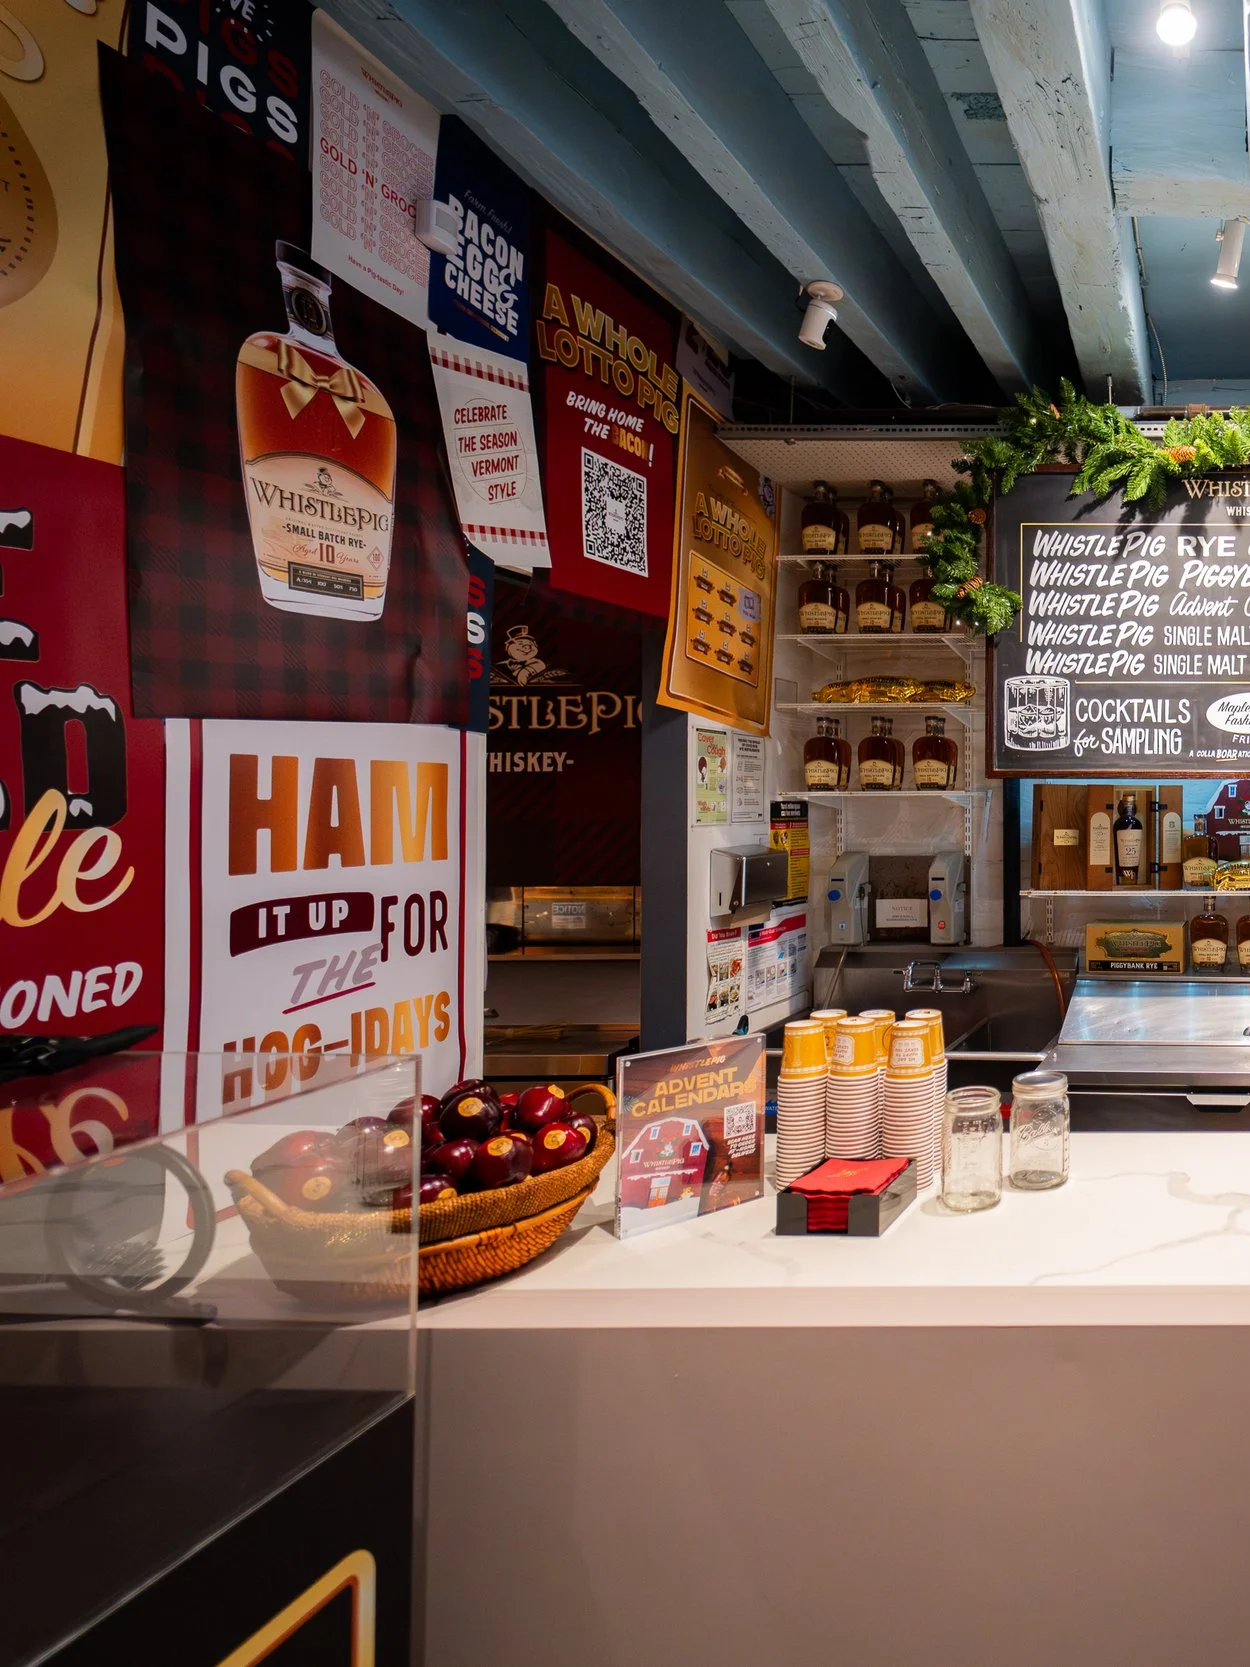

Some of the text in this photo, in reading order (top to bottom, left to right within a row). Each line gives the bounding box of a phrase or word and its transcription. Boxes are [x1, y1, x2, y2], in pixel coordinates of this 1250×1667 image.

[145, 1, 298, 143] PIGS
[320, 69, 360, 110] GOLD
[320, 86, 359, 127] GOLD
[320, 103, 359, 143] GOLD
[320, 119, 358, 159] GOLD
[320, 153, 357, 192] GOLD
[320, 137, 357, 175] GOLD
[381, 183, 416, 219] GROC
[320, 171, 357, 208] GOLD
[320, 188, 356, 224] GOLD
[320, 204, 356, 240] GOLD
[449, 193, 524, 282] BACON
[445, 262, 519, 336] CHEESE
[543, 282, 569, 327] A
[571, 294, 679, 402] WHOLE
[536, 320, 634, 396] LOTTO
[638, 375, 679, 434] PIG
[454, 404, 508, 425] CELEBRATE
[566, 391, 645, 433] BRING HOME
[458, 431, 518, 453] THE SEASON
[584, 417, 654, 468] THE BACON!
[471, 454, 520, 478] VERMONT
[250, 476, 389, 532] WHISTLEPIG
[488, 481, 516, 501] STYLE
[318, 530, 346, 546] BATCH
[692, 514, 742, 556] LOTTO
[696, 492, 767, 560] A WHOLE
[1033, 529, 1166, 558] WHISTLEPIG
[1178, 536, 1236, 557] RYE
[292, 543, 359, 565] Aged 10 Years
[1029, 559, 1170, 588] WHISTLEPIG
[1028, 590, 1160, 618] WHISTLEPIG
[1169, 592, 1239, 617] Advent
[1027, 620, 1154, 647] WHISTLEPIG
[1164, 626, 1212, 646] SINGLE
[1025, 648, 1146, 676] WHISTLEPIG
[1153, 654, 1203, 675] SINGLE
[1208, 654, 1247, 675] MALT
[489, 691, 642, 735] STLEPI
[1075, 698, 1192, 723] COCKTAILS
[1073, 728, 1182, 757] for SAMPLING
[1189, 750, 1194, 759] A
[229, 753, 449, 877] HAM
[258, 890, 449, 962] IT UP FOR
[291, 943, 384, 1004] THE
[654, 1067, 737, 1097] ADVENT
[668, 1056, 726, 1072] WHISTLEPIG
[631, 1076, 757, 1117] CALENDARS
